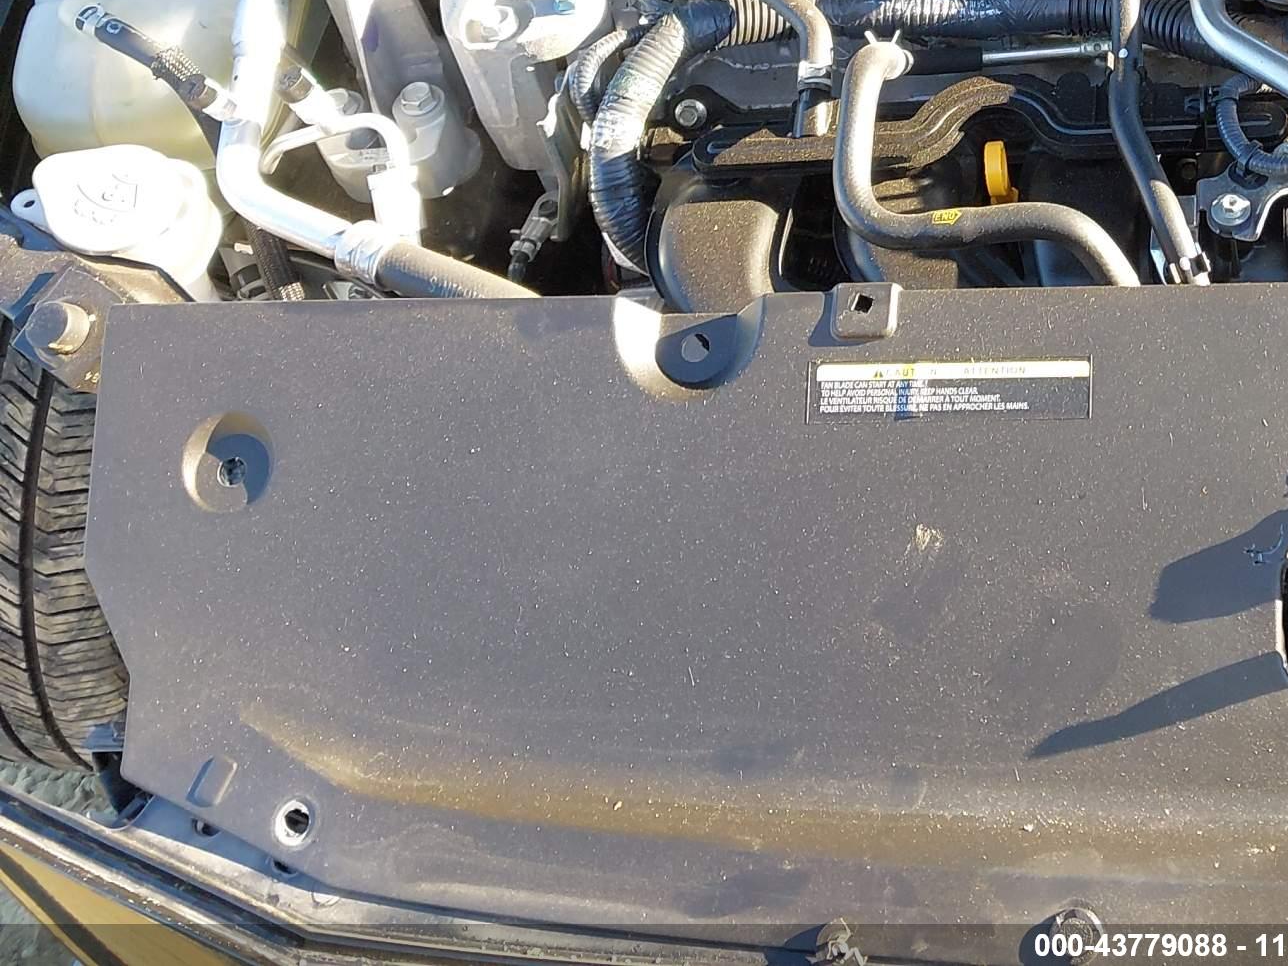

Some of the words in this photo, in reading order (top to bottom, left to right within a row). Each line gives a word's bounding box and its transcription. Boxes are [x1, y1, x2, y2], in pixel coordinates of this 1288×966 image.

[821, 381, 834, 389] FAN
[887, 380, 895, 388] AT
[895, 380, 908, 388] ANY
[821, 389, 830, 397] TO
[831, 389, 846, 397] HELP
[847, 389, 866, 397] AVOID
[867, 388, 898, 396] PERSONAL
[936, 387, 957, 395] HANDS
[820, 397, 828, 405] LE
[829, 396, 872, 405] VENTILATEUR
[873, 396, 898, 404] RISQUE
[898, 396, 907, 404] DE
[951, 395, 969, 403] TOUT
[820, 405, 838, 413] POUR
[919, 404, 928, 412] NE
[929, 403, 942, 411] PAS
[943, 403, 952, 411] EN
[953, 402, 993, 411] APPROCHER
[993, 402, 1005, 410] LES
